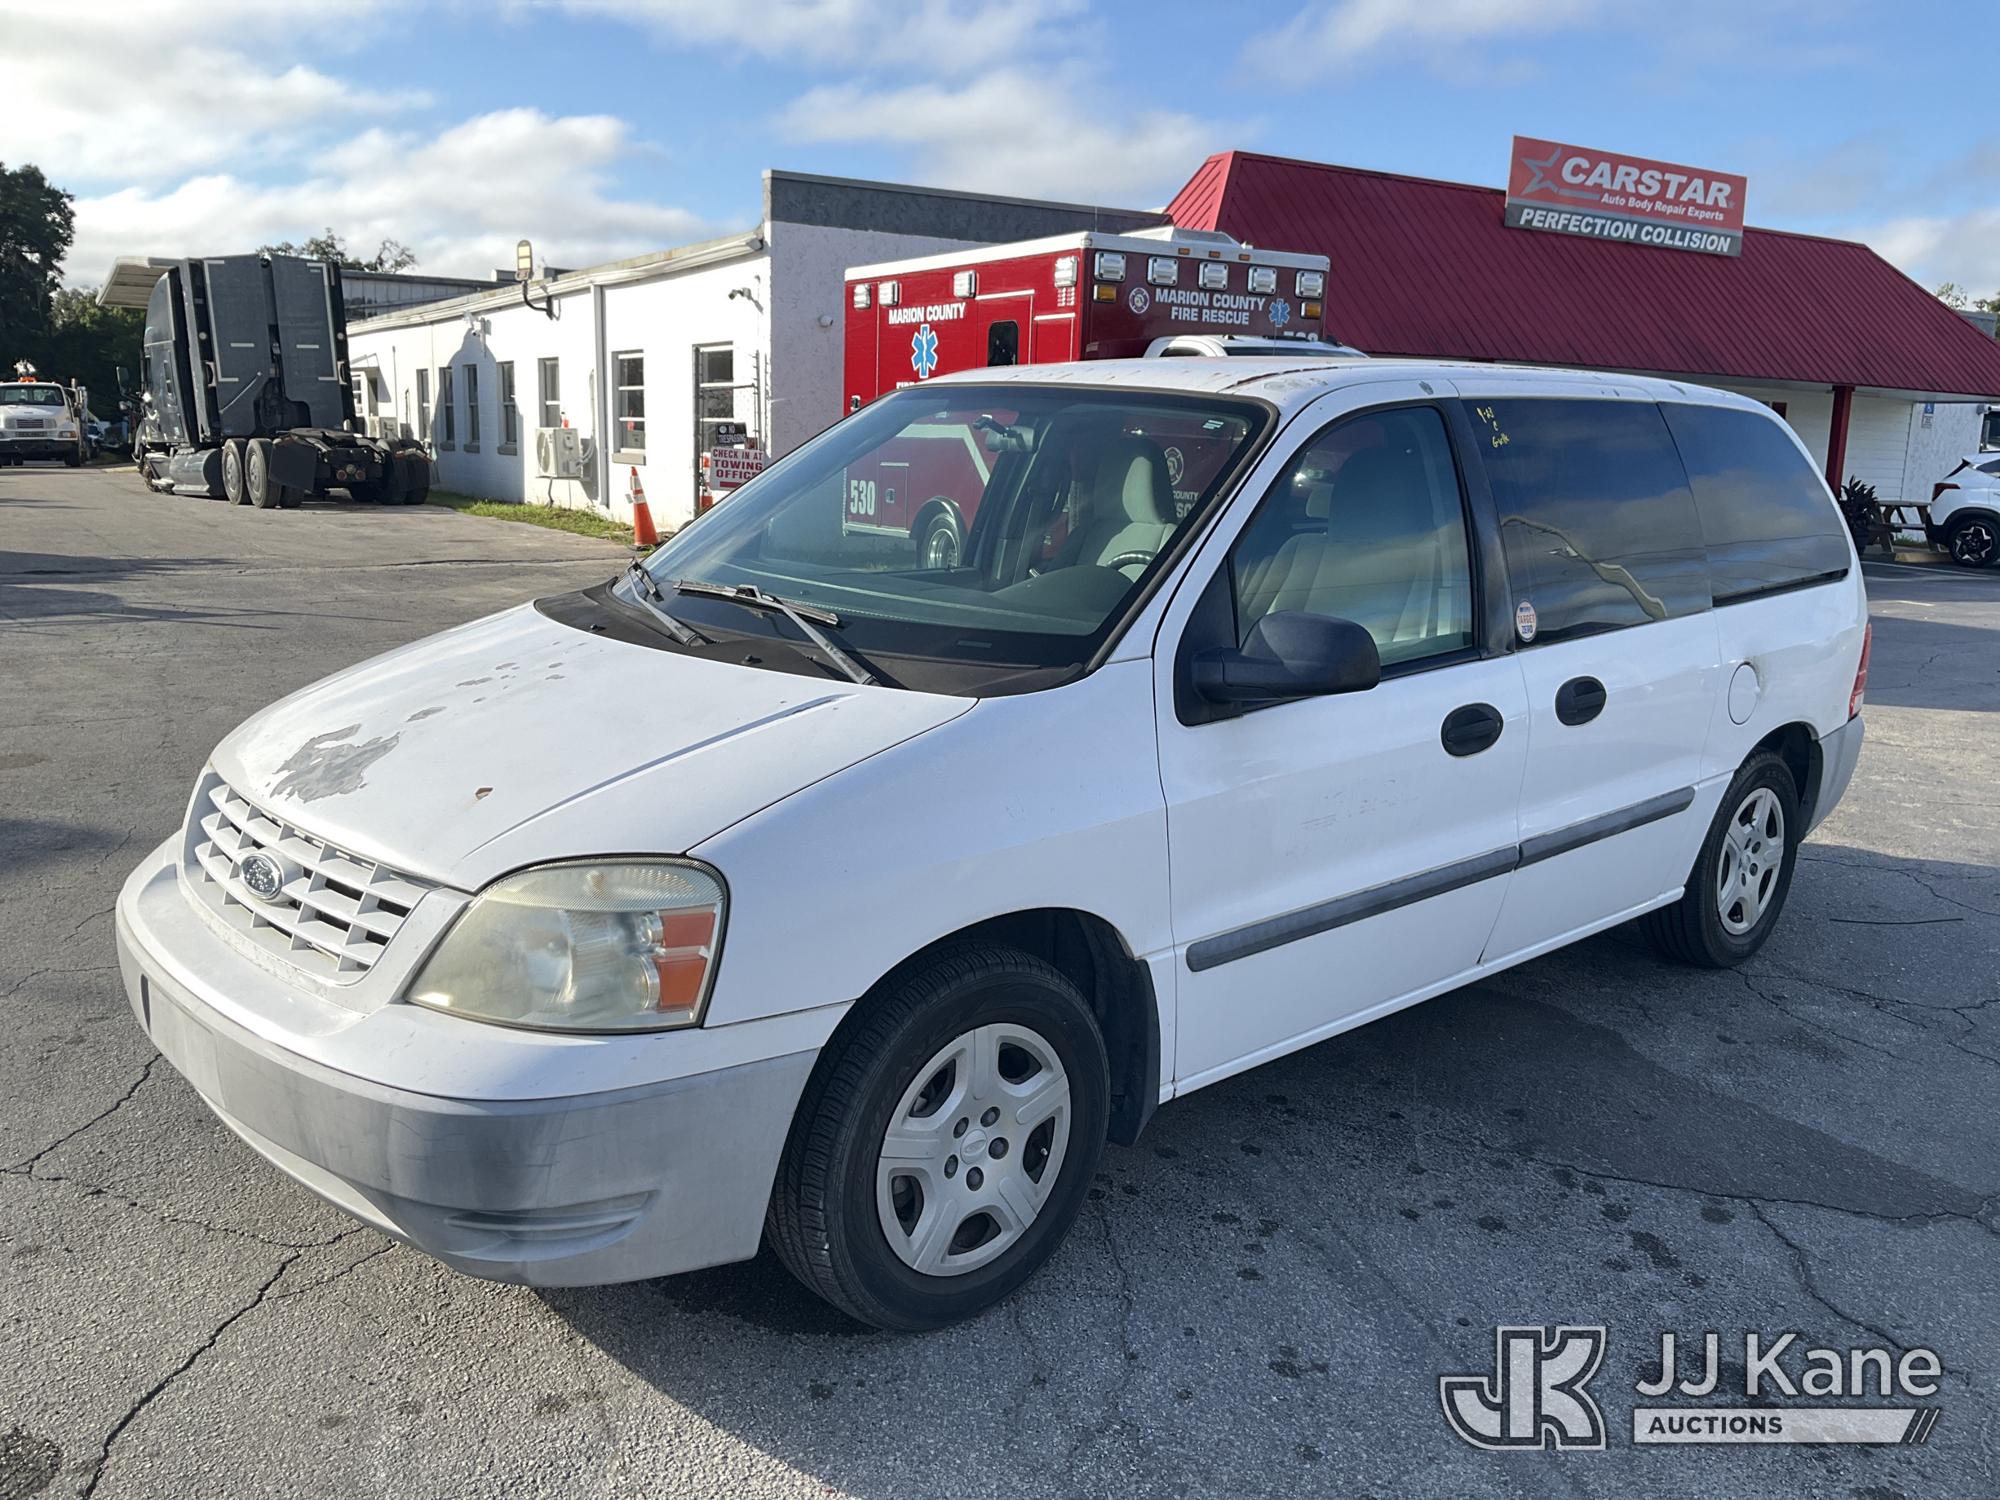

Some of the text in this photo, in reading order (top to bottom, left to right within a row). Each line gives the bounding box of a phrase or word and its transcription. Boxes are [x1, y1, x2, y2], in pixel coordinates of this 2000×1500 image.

[1561, 156, 1732, 208] CARSTAR
[1601, 192, 1725, 221] Auto Body Repair Experts
[1519, 207, 1732, 252] PERFECTION COLLISION
[1155, 287, 1266, 311] MARION COUNTY
[888, 302, 966, 325] MARION COUNTY
[1171, 306, 1250, 325] FIRE RESCUE
[713, 449, 764, 461] CHECK IN AT
[714, 459, 763, 471] TOWING
[850, 479, 876, 515] 530
